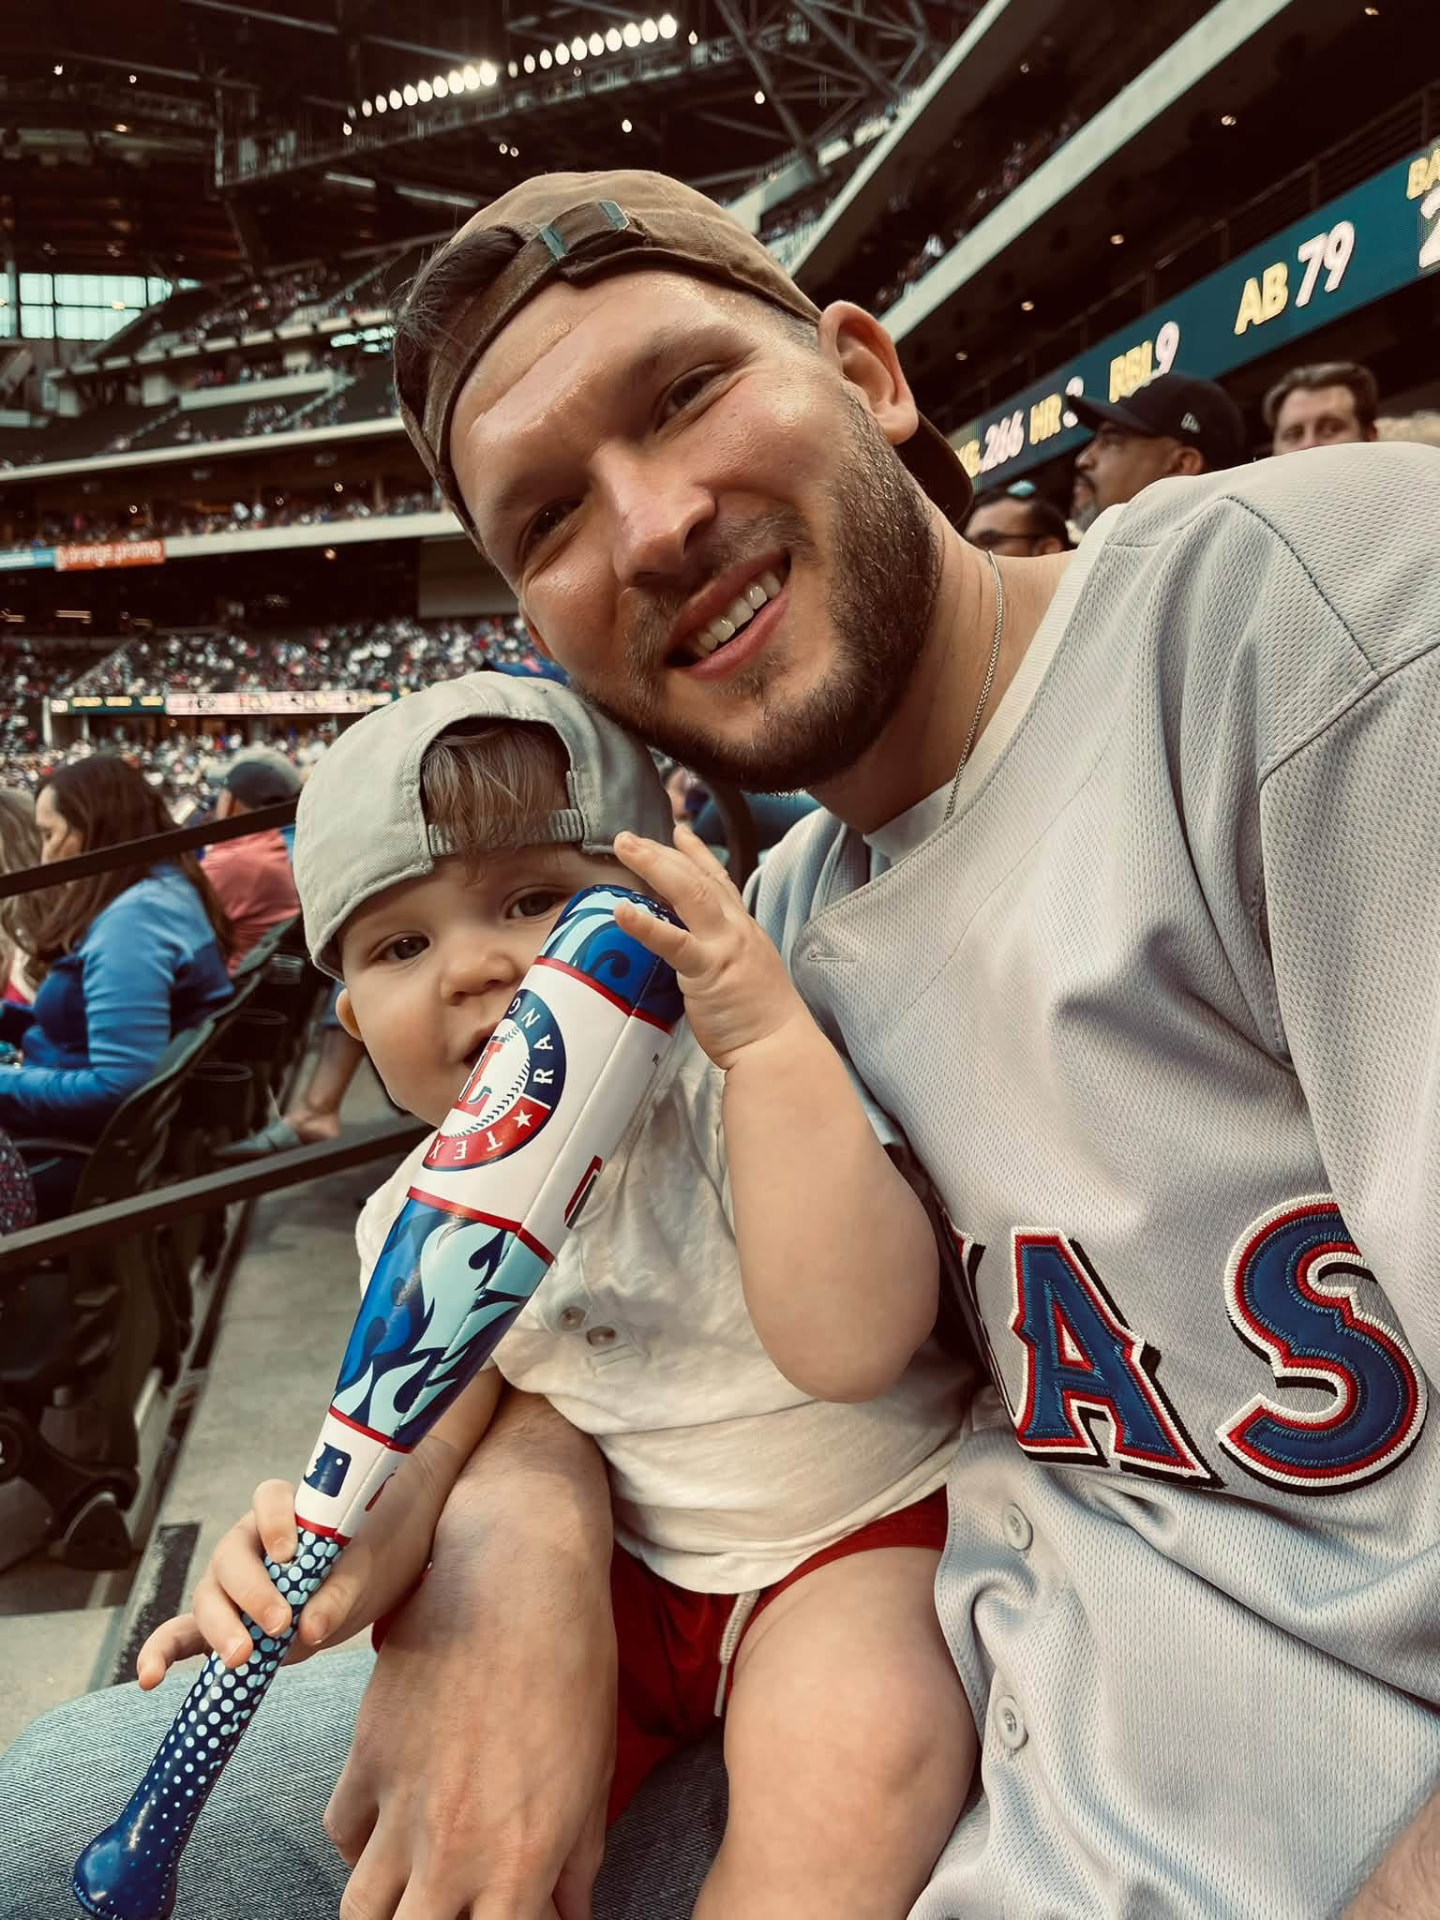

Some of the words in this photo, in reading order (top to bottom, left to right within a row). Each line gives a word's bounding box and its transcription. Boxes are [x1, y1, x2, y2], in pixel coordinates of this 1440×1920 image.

[1110, 340, 1152, 403] RBI
[1156, 321, 1180, 374] 9
[1234, 262, 1289, 335] AB
[1295, 220, 1356, 308] 79
[940, 1192, 1429, 1497] AS
